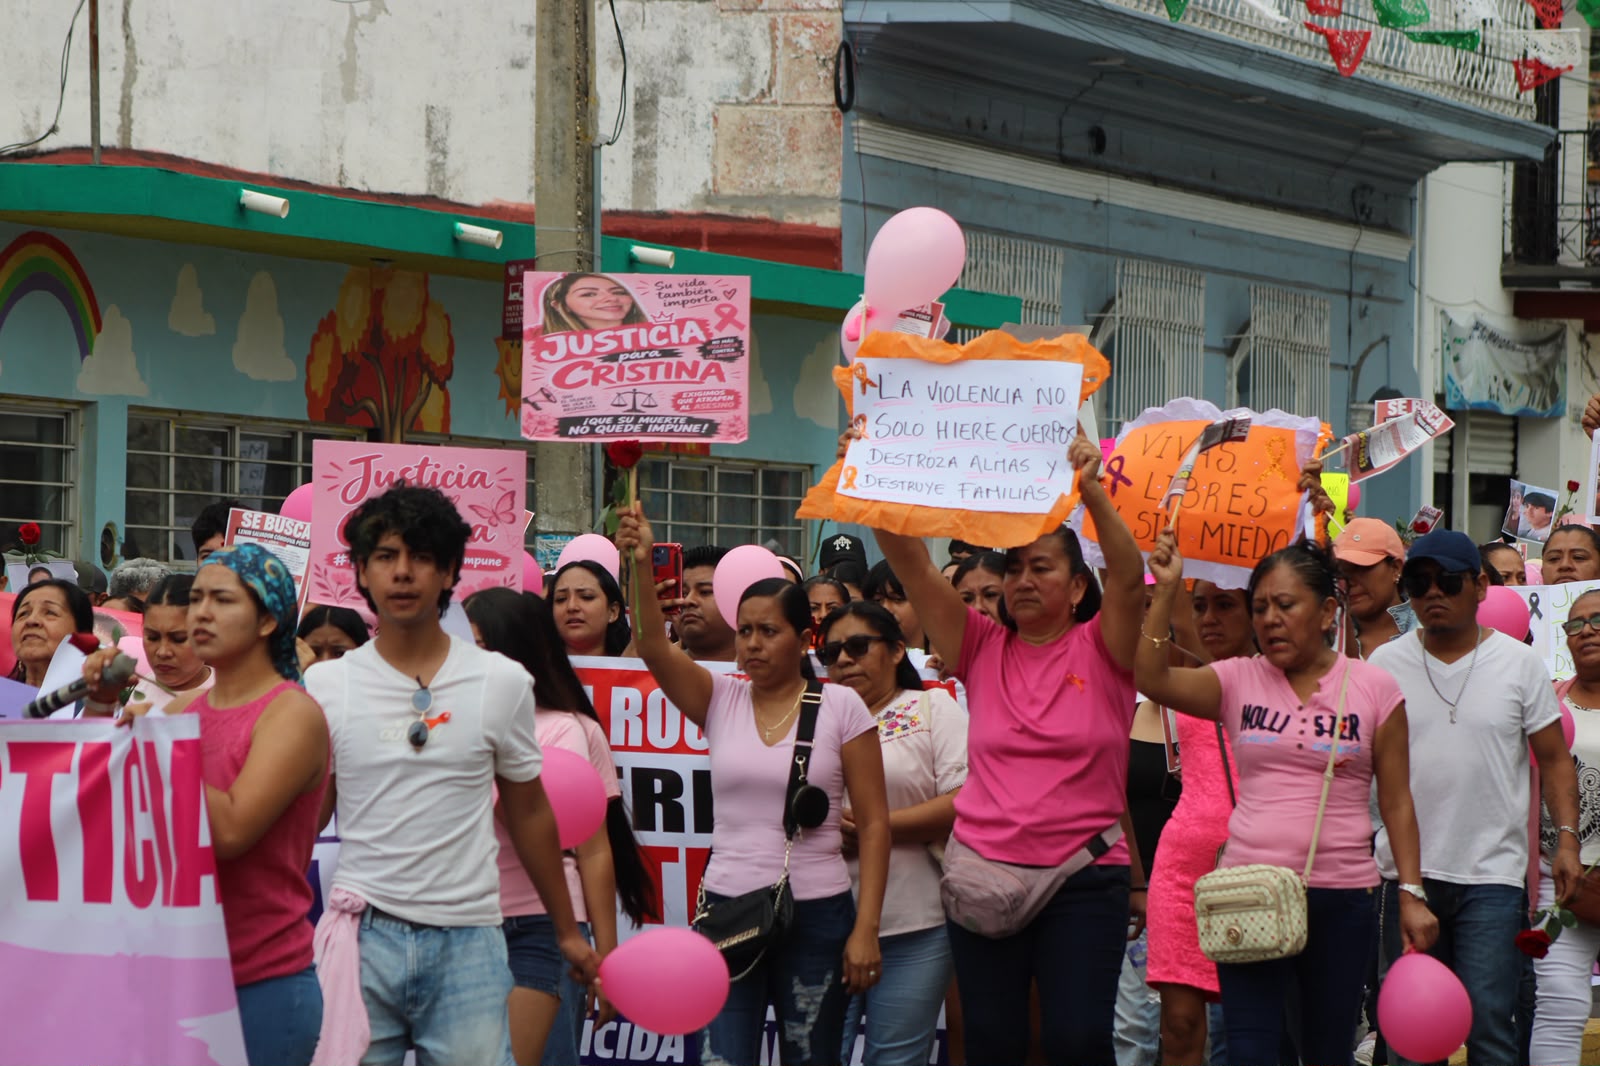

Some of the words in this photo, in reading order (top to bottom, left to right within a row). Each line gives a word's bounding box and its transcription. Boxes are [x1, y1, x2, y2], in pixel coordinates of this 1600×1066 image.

[654, 281, 672, 290] Su
[678, 278, 706, 288] vida
[657, 287, 713, 299] también
[663, 295, 720, 308] importa
[540, 320, 707, 362] JUSTICIA
[618, 349, 662, 364] para
[552, 360, 727, 389] CRISTINA
[682, 389, 726, 398] EXIGIMOS
[878, 373, 913, 400] LA
[928, 381, 1023, 405] VIOLENCIA
[1036, 387, 1066, 406] NO
[677, 397, 693, 405] QUE
[695, 395, 735, 403] ATRAPEN
[693, 402, 735, 410] ASESINO
[1387, 400, 1407, 415] SE
[618, 416, 635, 424] SU
[639, 416, 688, 424] MUERTE
[568, 425, 591, 435] NO
[595, 424, 643, 435] QUEDE
[647, 423, 709, 434] IMPUNE!
[875, 412, 925, 439] SOLO
[936, 420, 998, 441] HIERE
[1002, 420, 1077, 446] CUERPOS
[866, 448, 959, 470] DESTROZA
[969, 455, 1030, 474] ALMAS
[340, 454, 494, 504] Justicia
[860, 474, 946, 496] DESTRUYE
[241, 510, 262, 530] SE
[263, 514, 311, 540] BUSCA
[0, 736, 224, 909] TICIA
